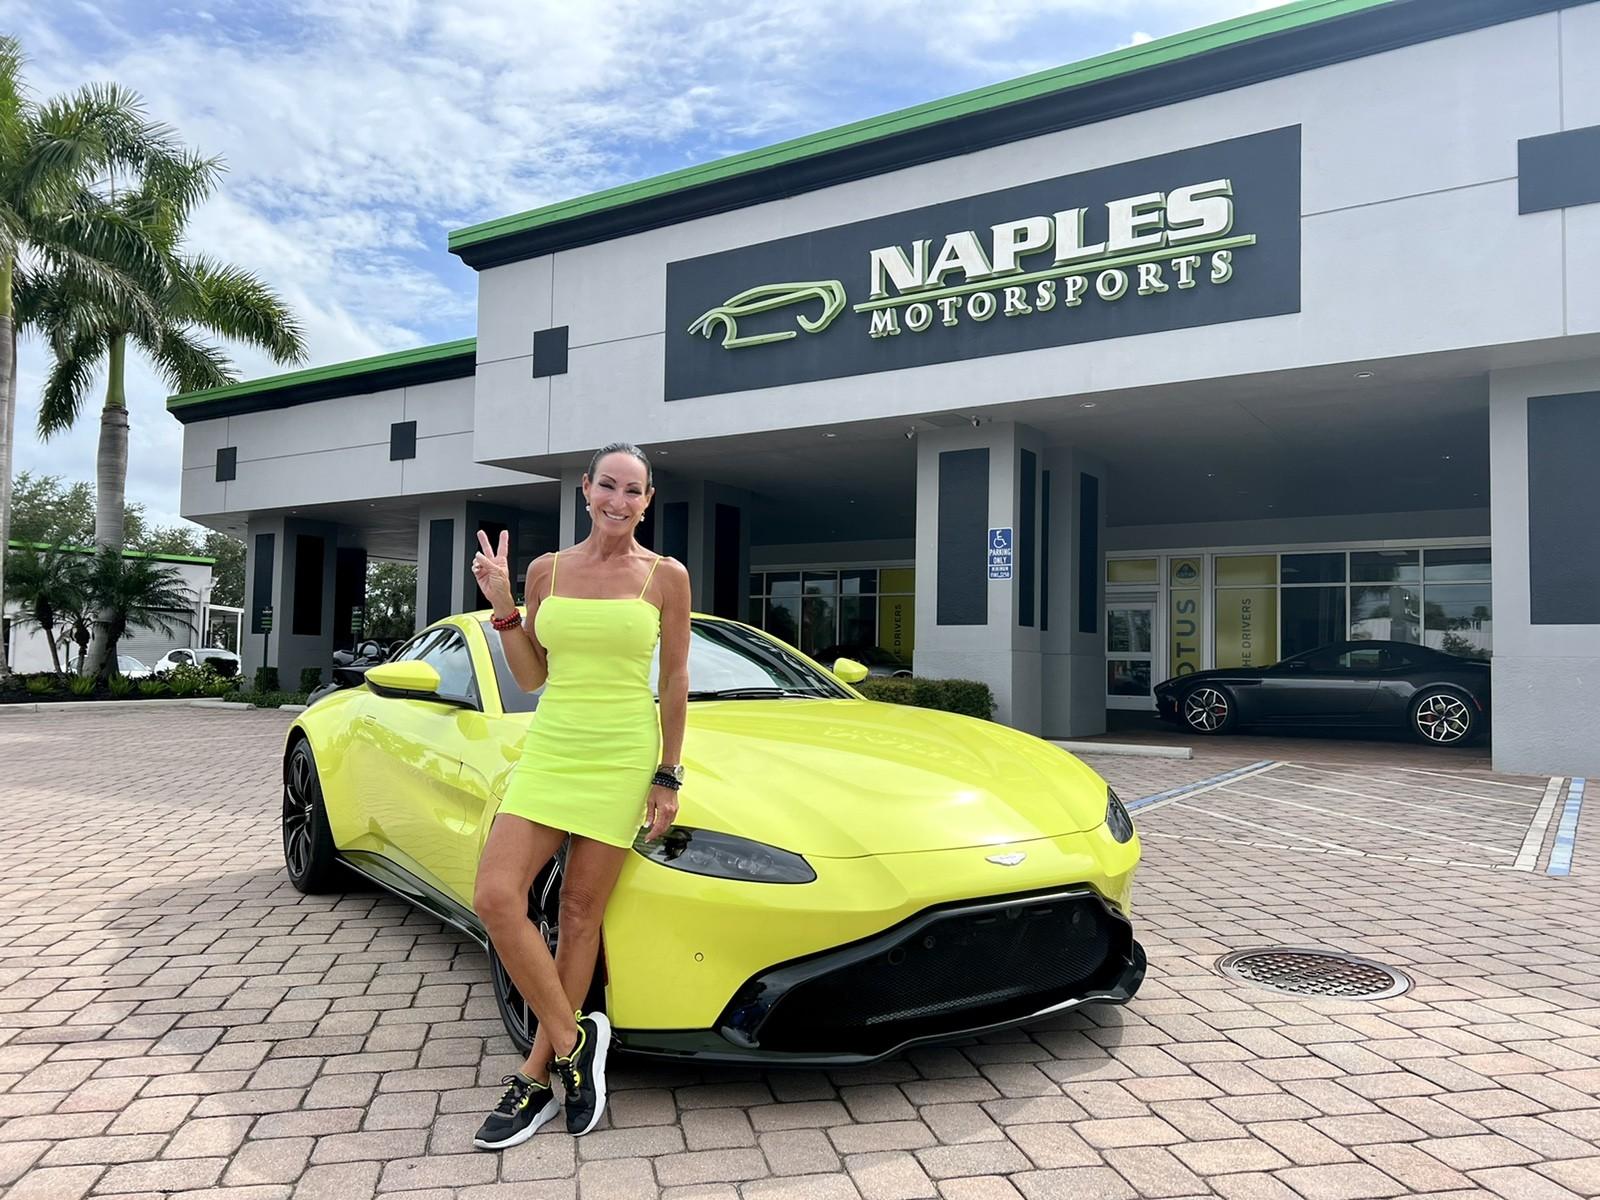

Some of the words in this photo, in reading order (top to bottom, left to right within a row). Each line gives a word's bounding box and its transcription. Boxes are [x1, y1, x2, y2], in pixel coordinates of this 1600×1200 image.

[870, 179, 1233, 300] NAPLES
[868, 250, 1233, 339] MOTORSPORTS
[989, 548, 1011, 556] PARKING
[993, 556, 1007, 564] ONLY
[894, 603, 902, 646] DRIVERS
[1176, 599, 1196, 676] OTUS
[1241, 598, 1251, 649] DRIVERS
[1241, 651, 1251, 668] HE
